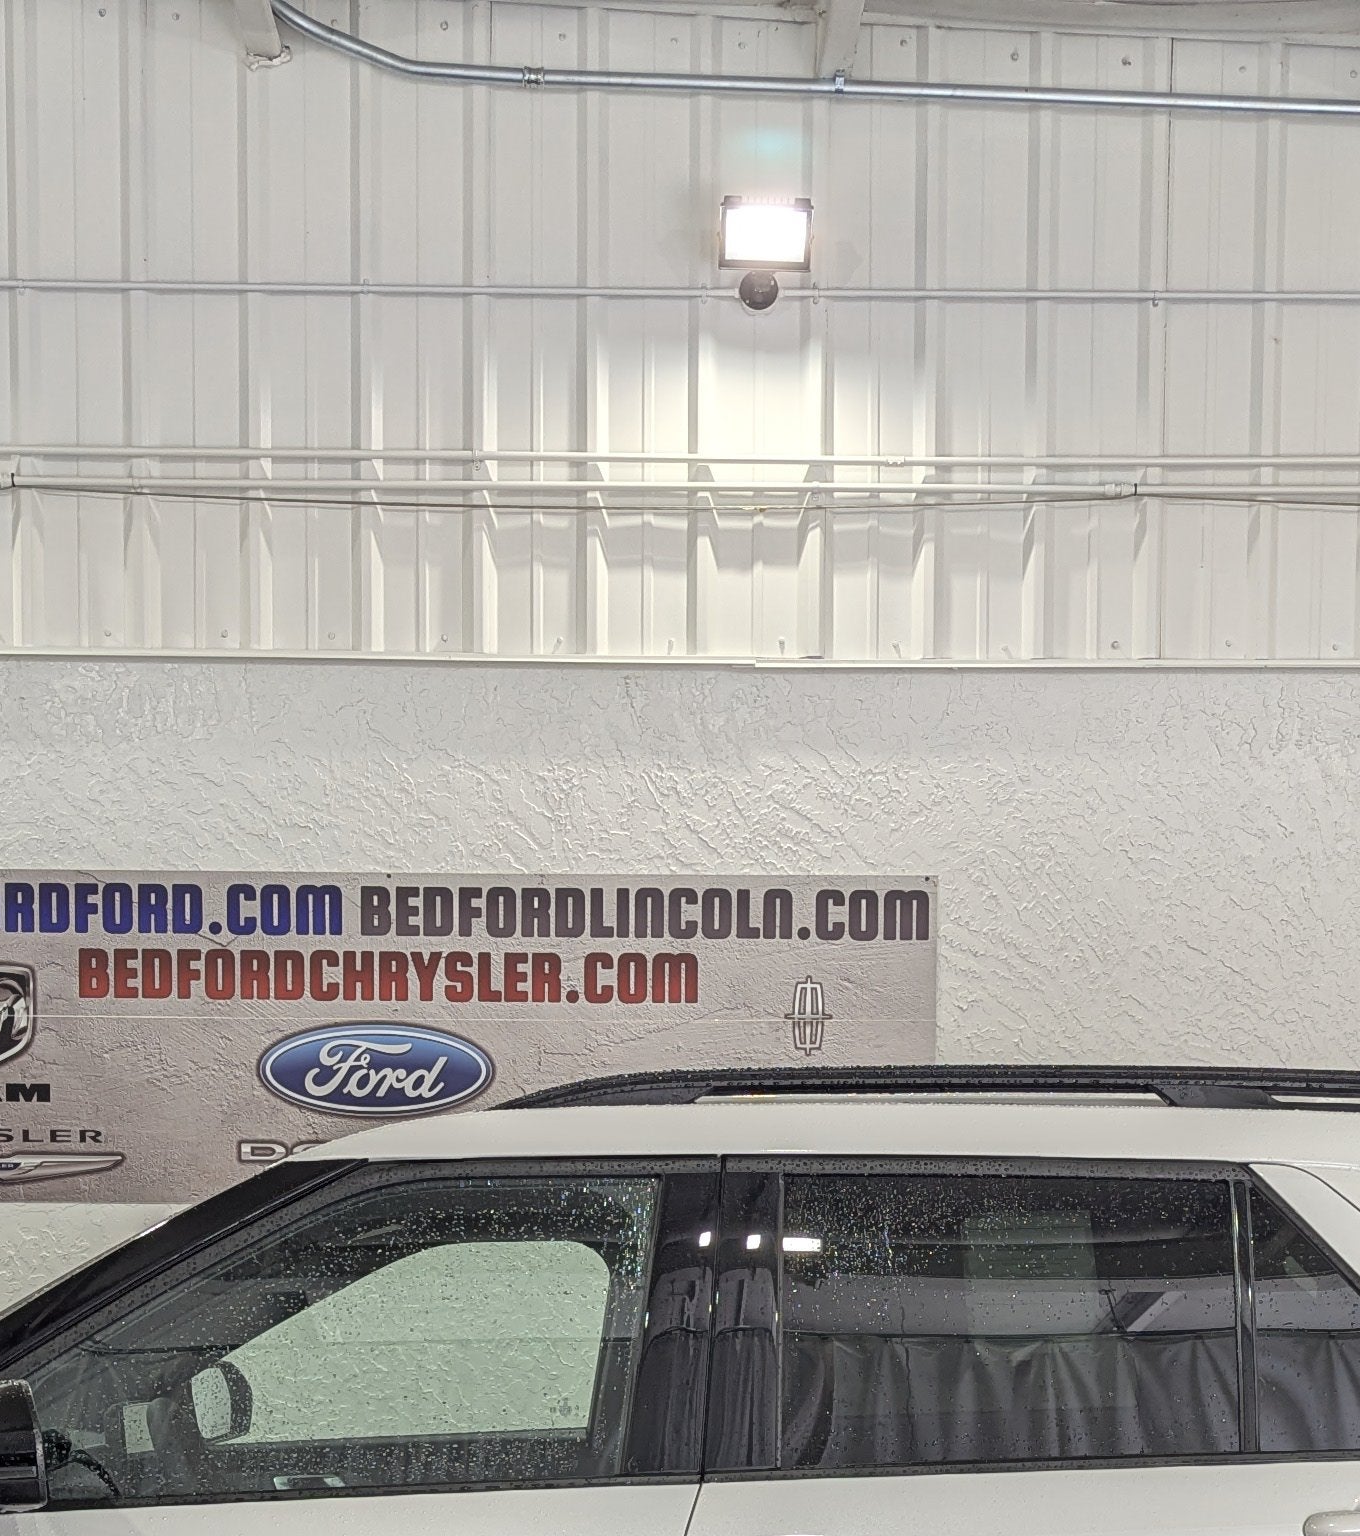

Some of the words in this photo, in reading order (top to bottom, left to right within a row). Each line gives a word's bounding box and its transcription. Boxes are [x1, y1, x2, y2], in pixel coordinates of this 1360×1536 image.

[359, 886, 930, 941] BEDFORDLINCOLN.COM
[79, 948, 699, 1004] BEDFORDCHRYSLER.COM
[304, 1039, 448, 1098] Ford
